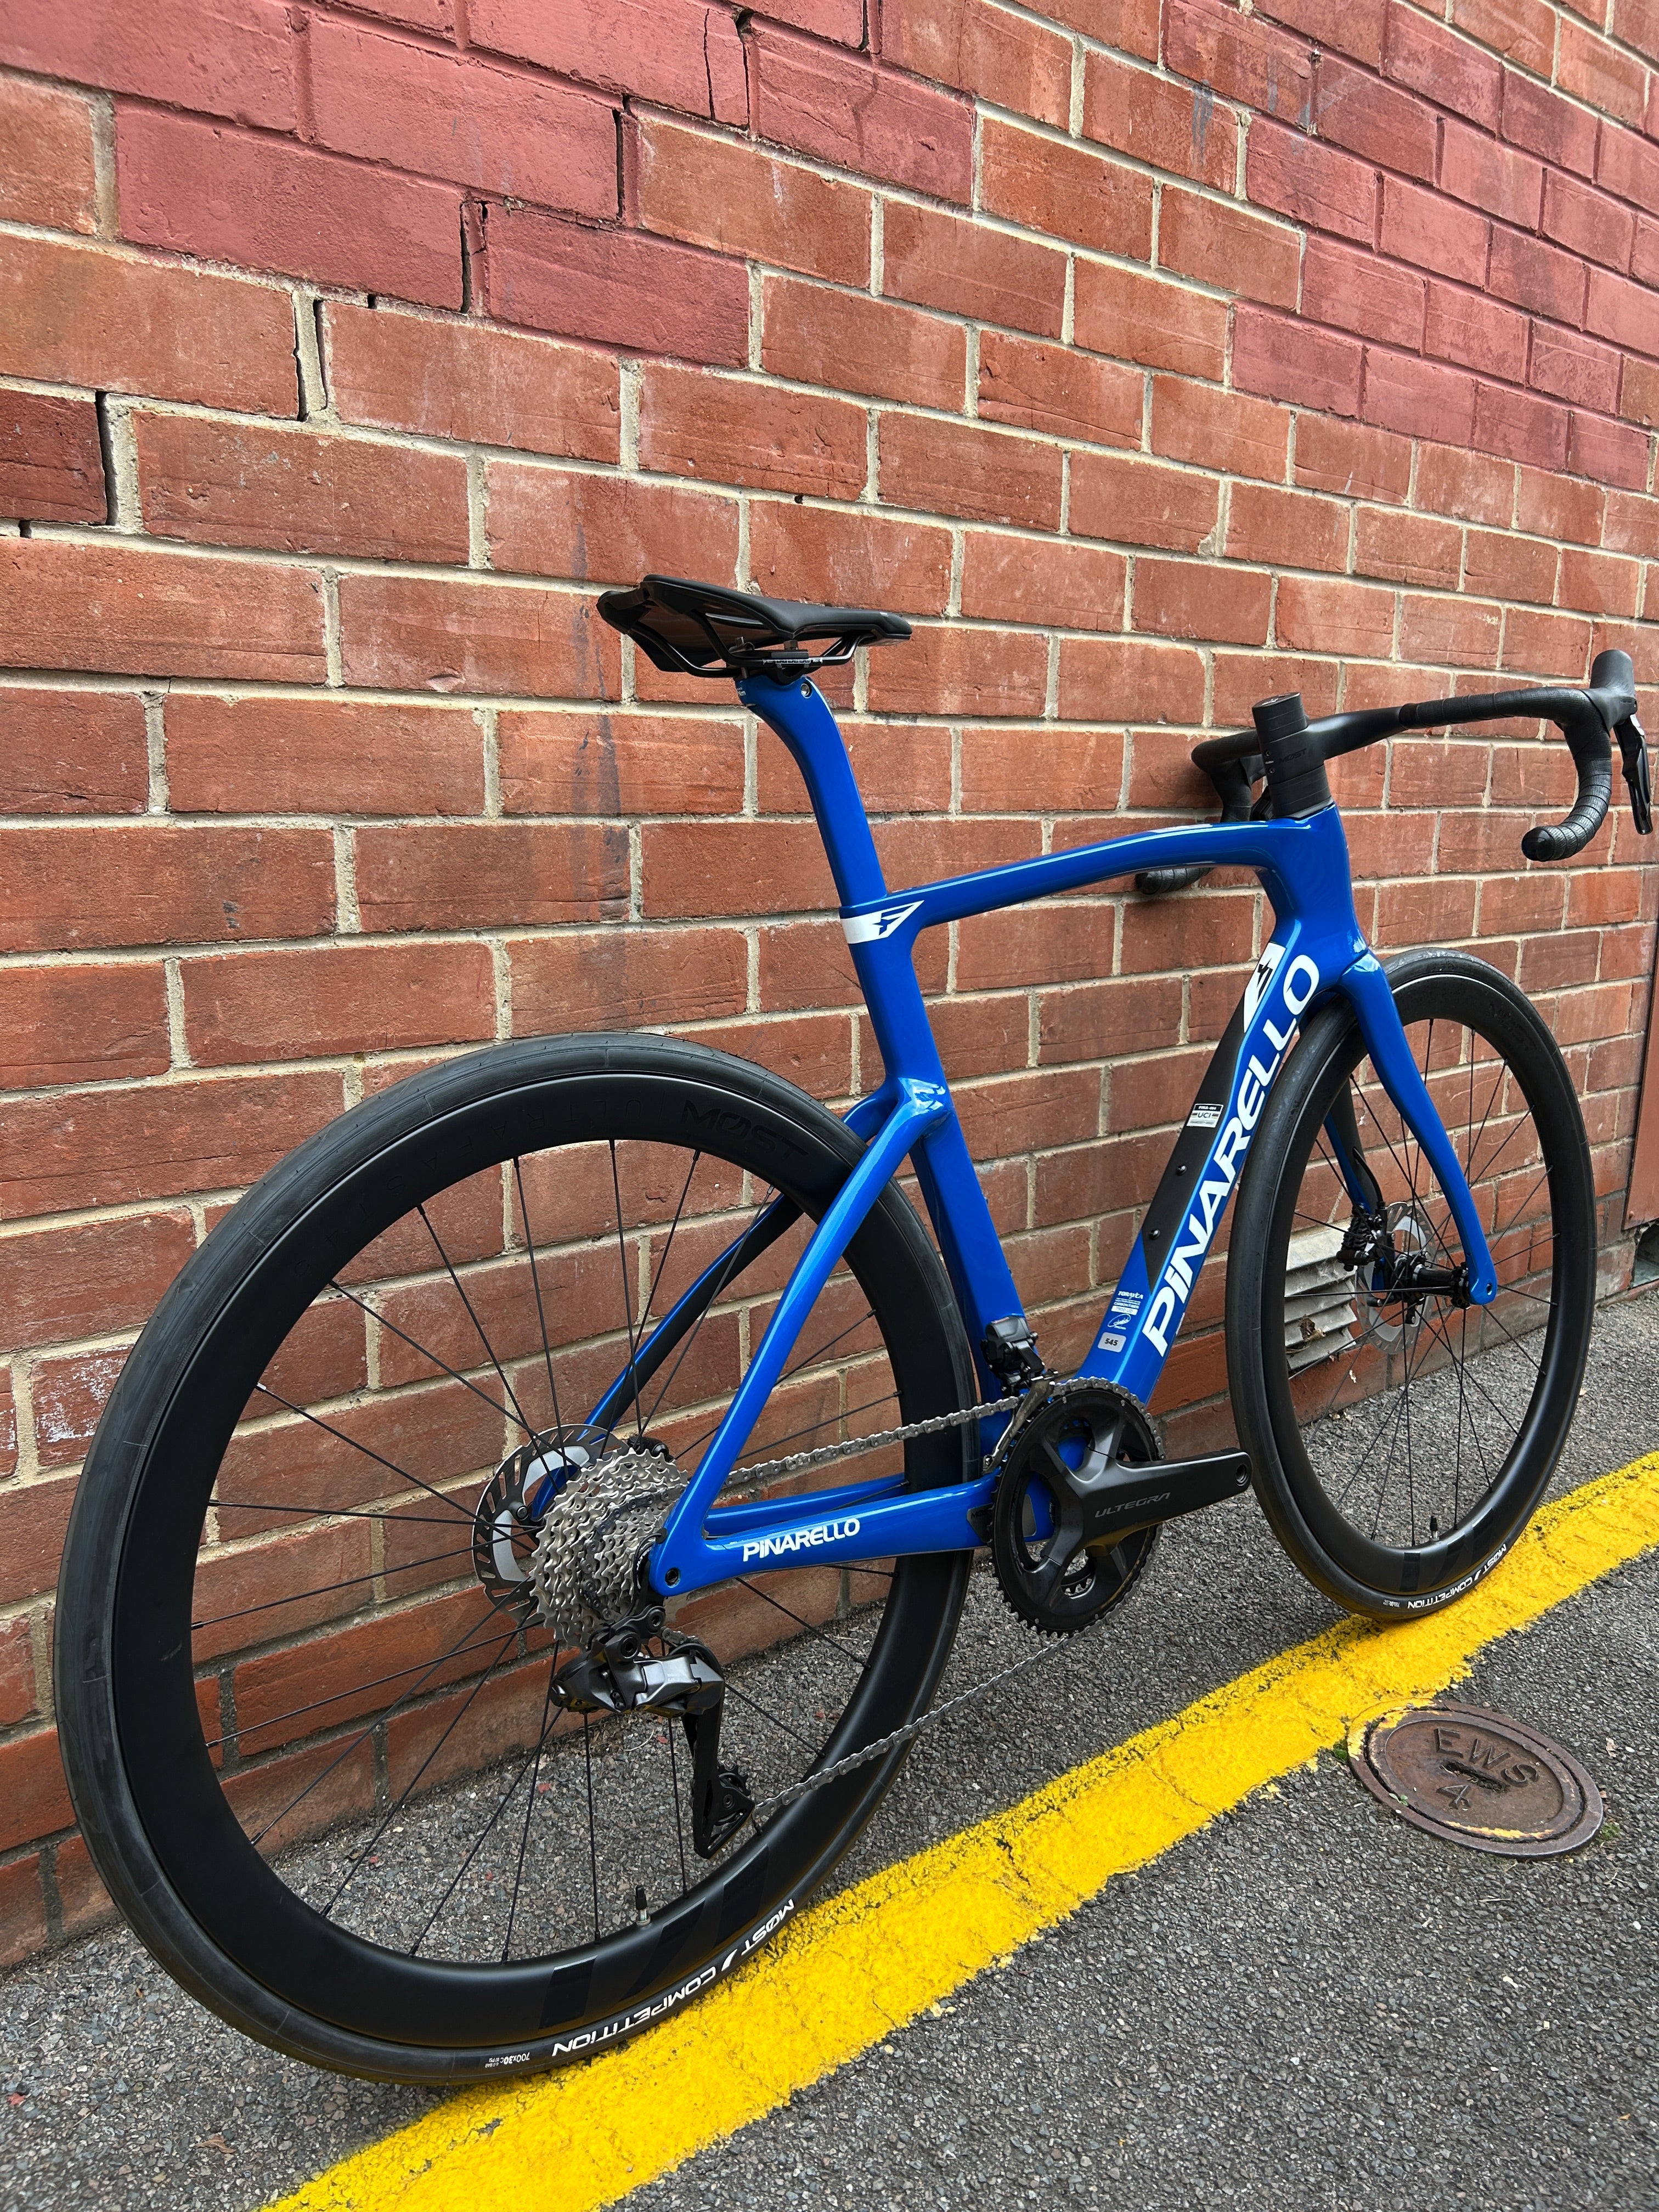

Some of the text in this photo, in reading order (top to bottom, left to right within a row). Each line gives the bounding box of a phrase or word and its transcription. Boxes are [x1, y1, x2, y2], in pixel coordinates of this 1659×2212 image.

[1142, 955, 1319, 1357] PINARELLO
[1094, 1492, 1171, 1518] ULTEGRA
[743, 1518, 860, 1562] PINARELLO
[1407, 1577, 1472, 1609] COMPETITION
[1434, 1727, 1539, 1788] EWS
[552, 1966, 716, 2056] COMPETITION
